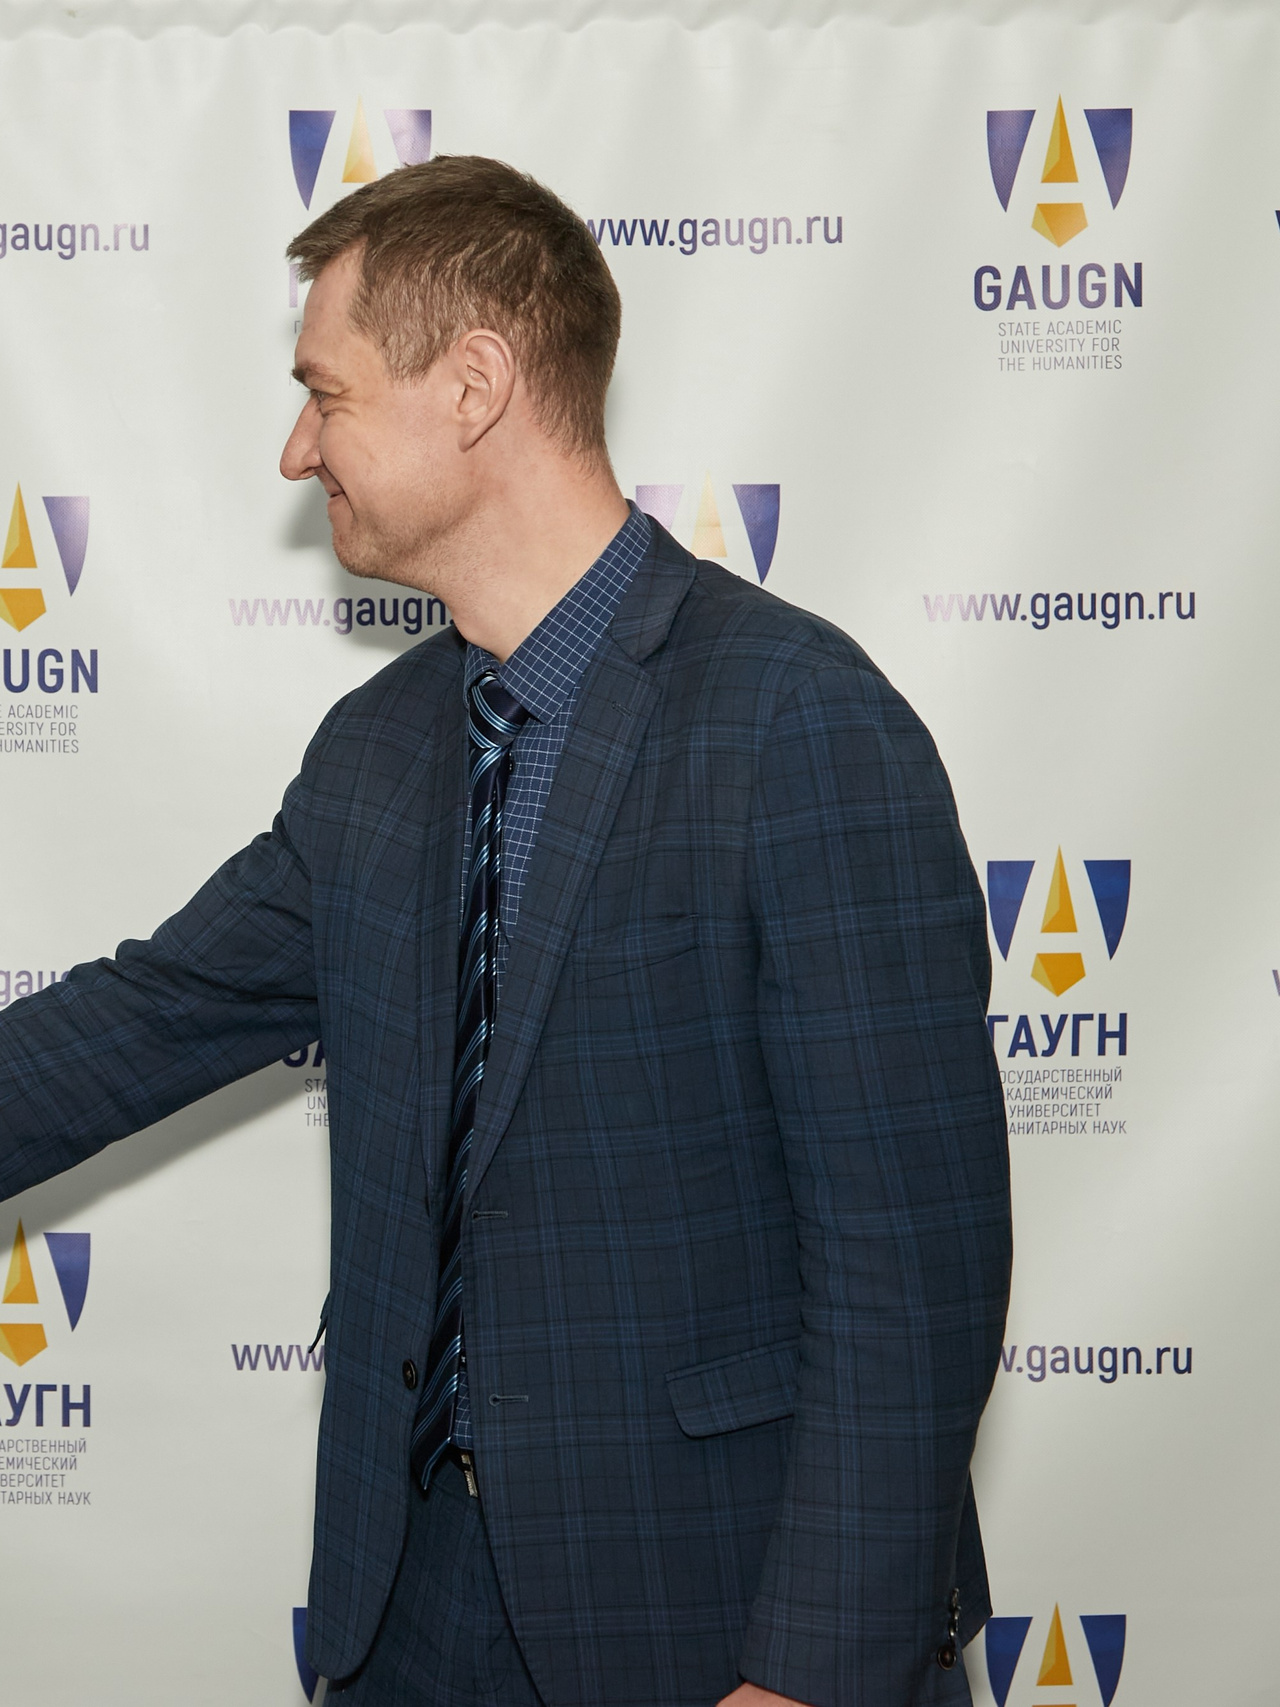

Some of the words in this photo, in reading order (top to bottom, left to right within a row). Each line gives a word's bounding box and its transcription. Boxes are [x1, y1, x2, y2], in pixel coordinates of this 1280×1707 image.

[973, 262, 1143, 312] GAUGN
[998, 321, 1041, 337] STATE
[1046, 319, 1122, 335] ACADEMIC
[1000, 338, 1085, 354] UNIVERSITY
[1092, 337, 1120, 352] FOR
[998, 356, 1026, 371] THE
[1032, 354, 1123, 371] HUMANITIES
[228, 597, 455, 636] www.gaugn.
[923, 591, 1196, 630] www.gaugn.ru
[7, 704, 79, 719] ACADEMIC
[50, 721, 77, 736] FOR
[986, 1013, 1127, 1058] ГАУГН
[1000, 1066, 1122, 1085] ОСУДАРСТВЕННЫЙ
[1006, 1083, 1113, 1102] КАДЕМИЧЕСКИЙ
[1009, 1103, 1101, 1118] УНИВЕРСИТЕТ
[1008, 1120, 1087, 1135] АНИТАРНЫХ
[1092, 1120, 1127, 1135] НАУК
[57, 1491, 91, 1506] НАУК
